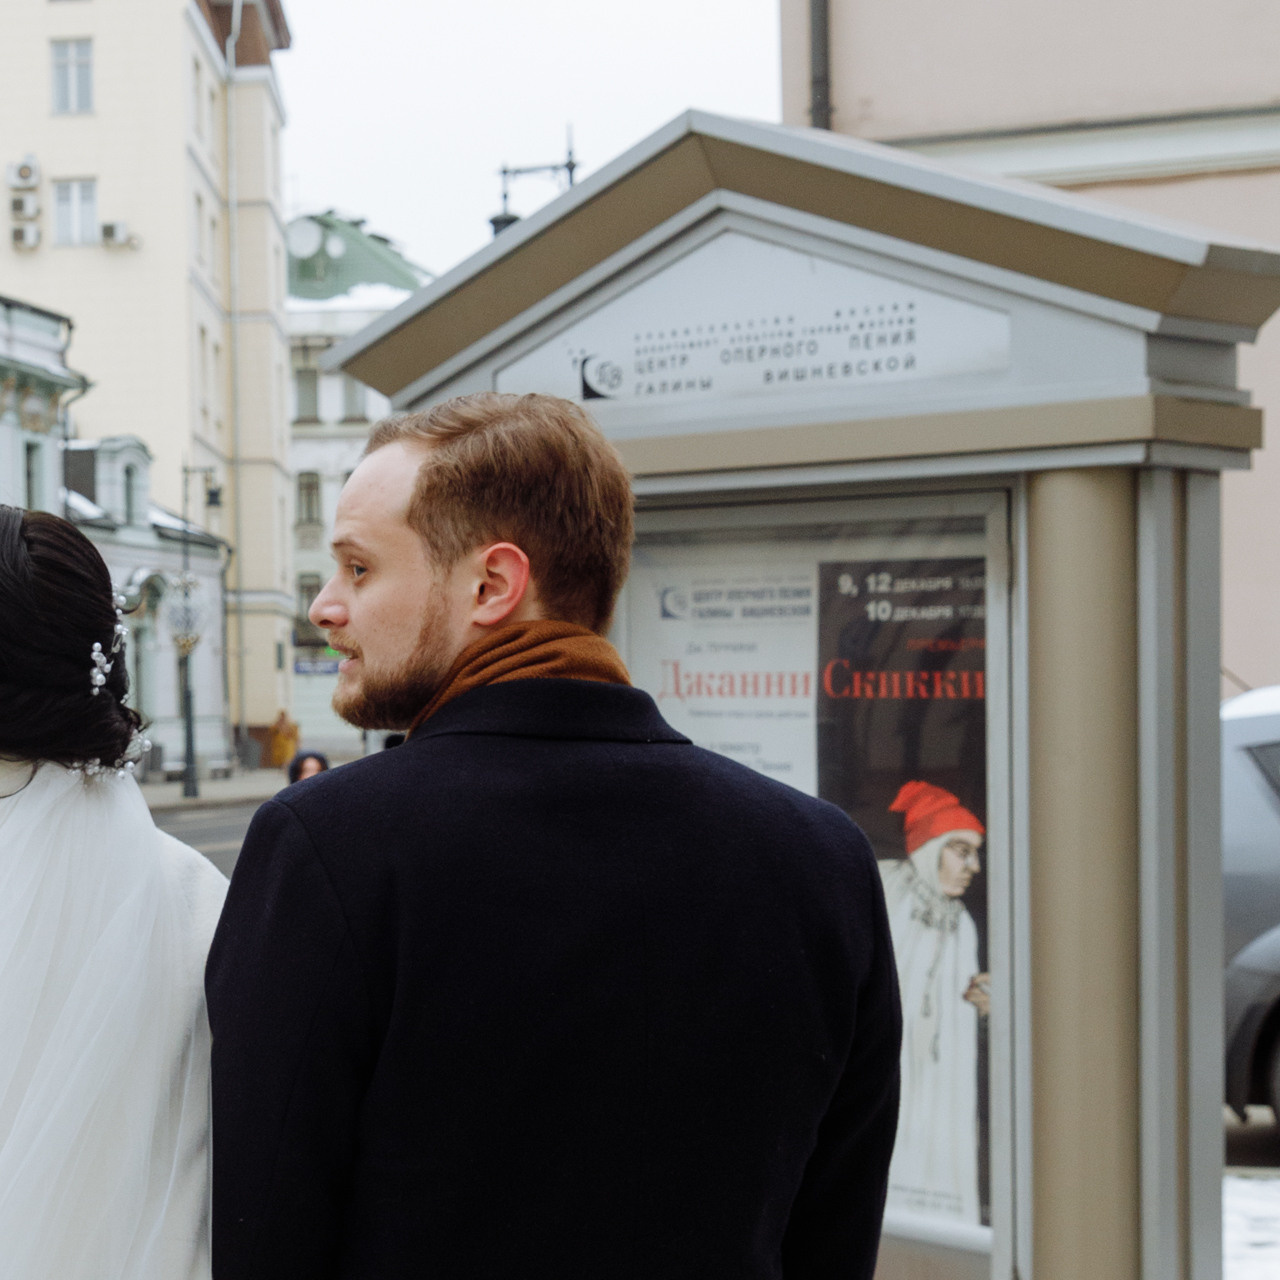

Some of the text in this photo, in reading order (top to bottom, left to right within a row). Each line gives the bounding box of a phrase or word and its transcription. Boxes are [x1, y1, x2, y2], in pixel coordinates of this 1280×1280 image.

[635, 354, 688, 375] ЦЕНТР
[720, 339, 818, 365] ОПЕРНОГО
[849, 328, 916, 350] ПЕНИЯ
[635, 353, 916, 396] ГАЛИНЫ ВИШНЕВСКОЙ
[866, 572, 892, 593] 12
[865, 600, 892, 621] 10
[658, 658, 985, 702] Джанни Скикки
